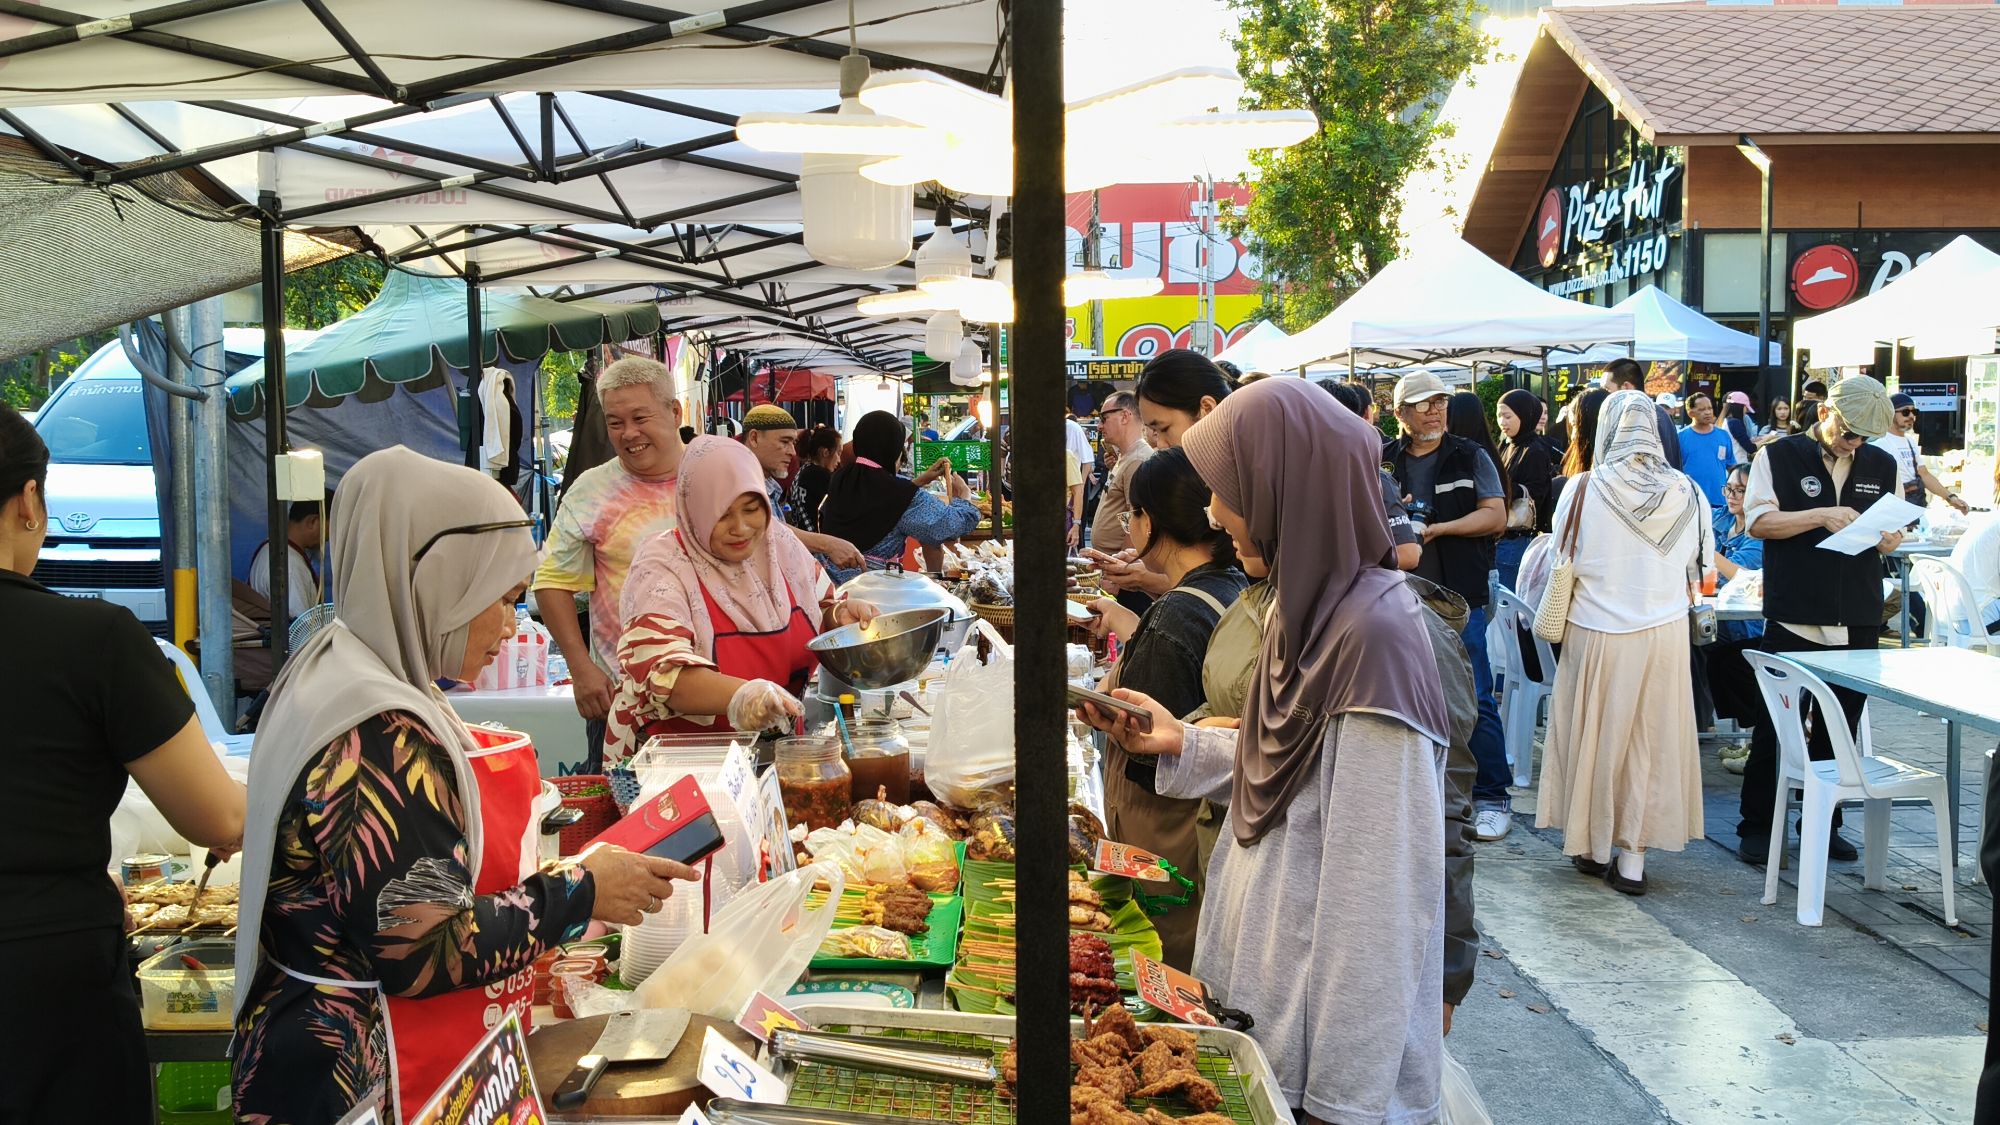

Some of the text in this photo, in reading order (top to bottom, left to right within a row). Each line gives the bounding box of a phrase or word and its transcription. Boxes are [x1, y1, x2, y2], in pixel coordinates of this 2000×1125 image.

[1564, 157, 1675, 254] Pizza Hut
[1623, 234, 1667, 278] 1150
